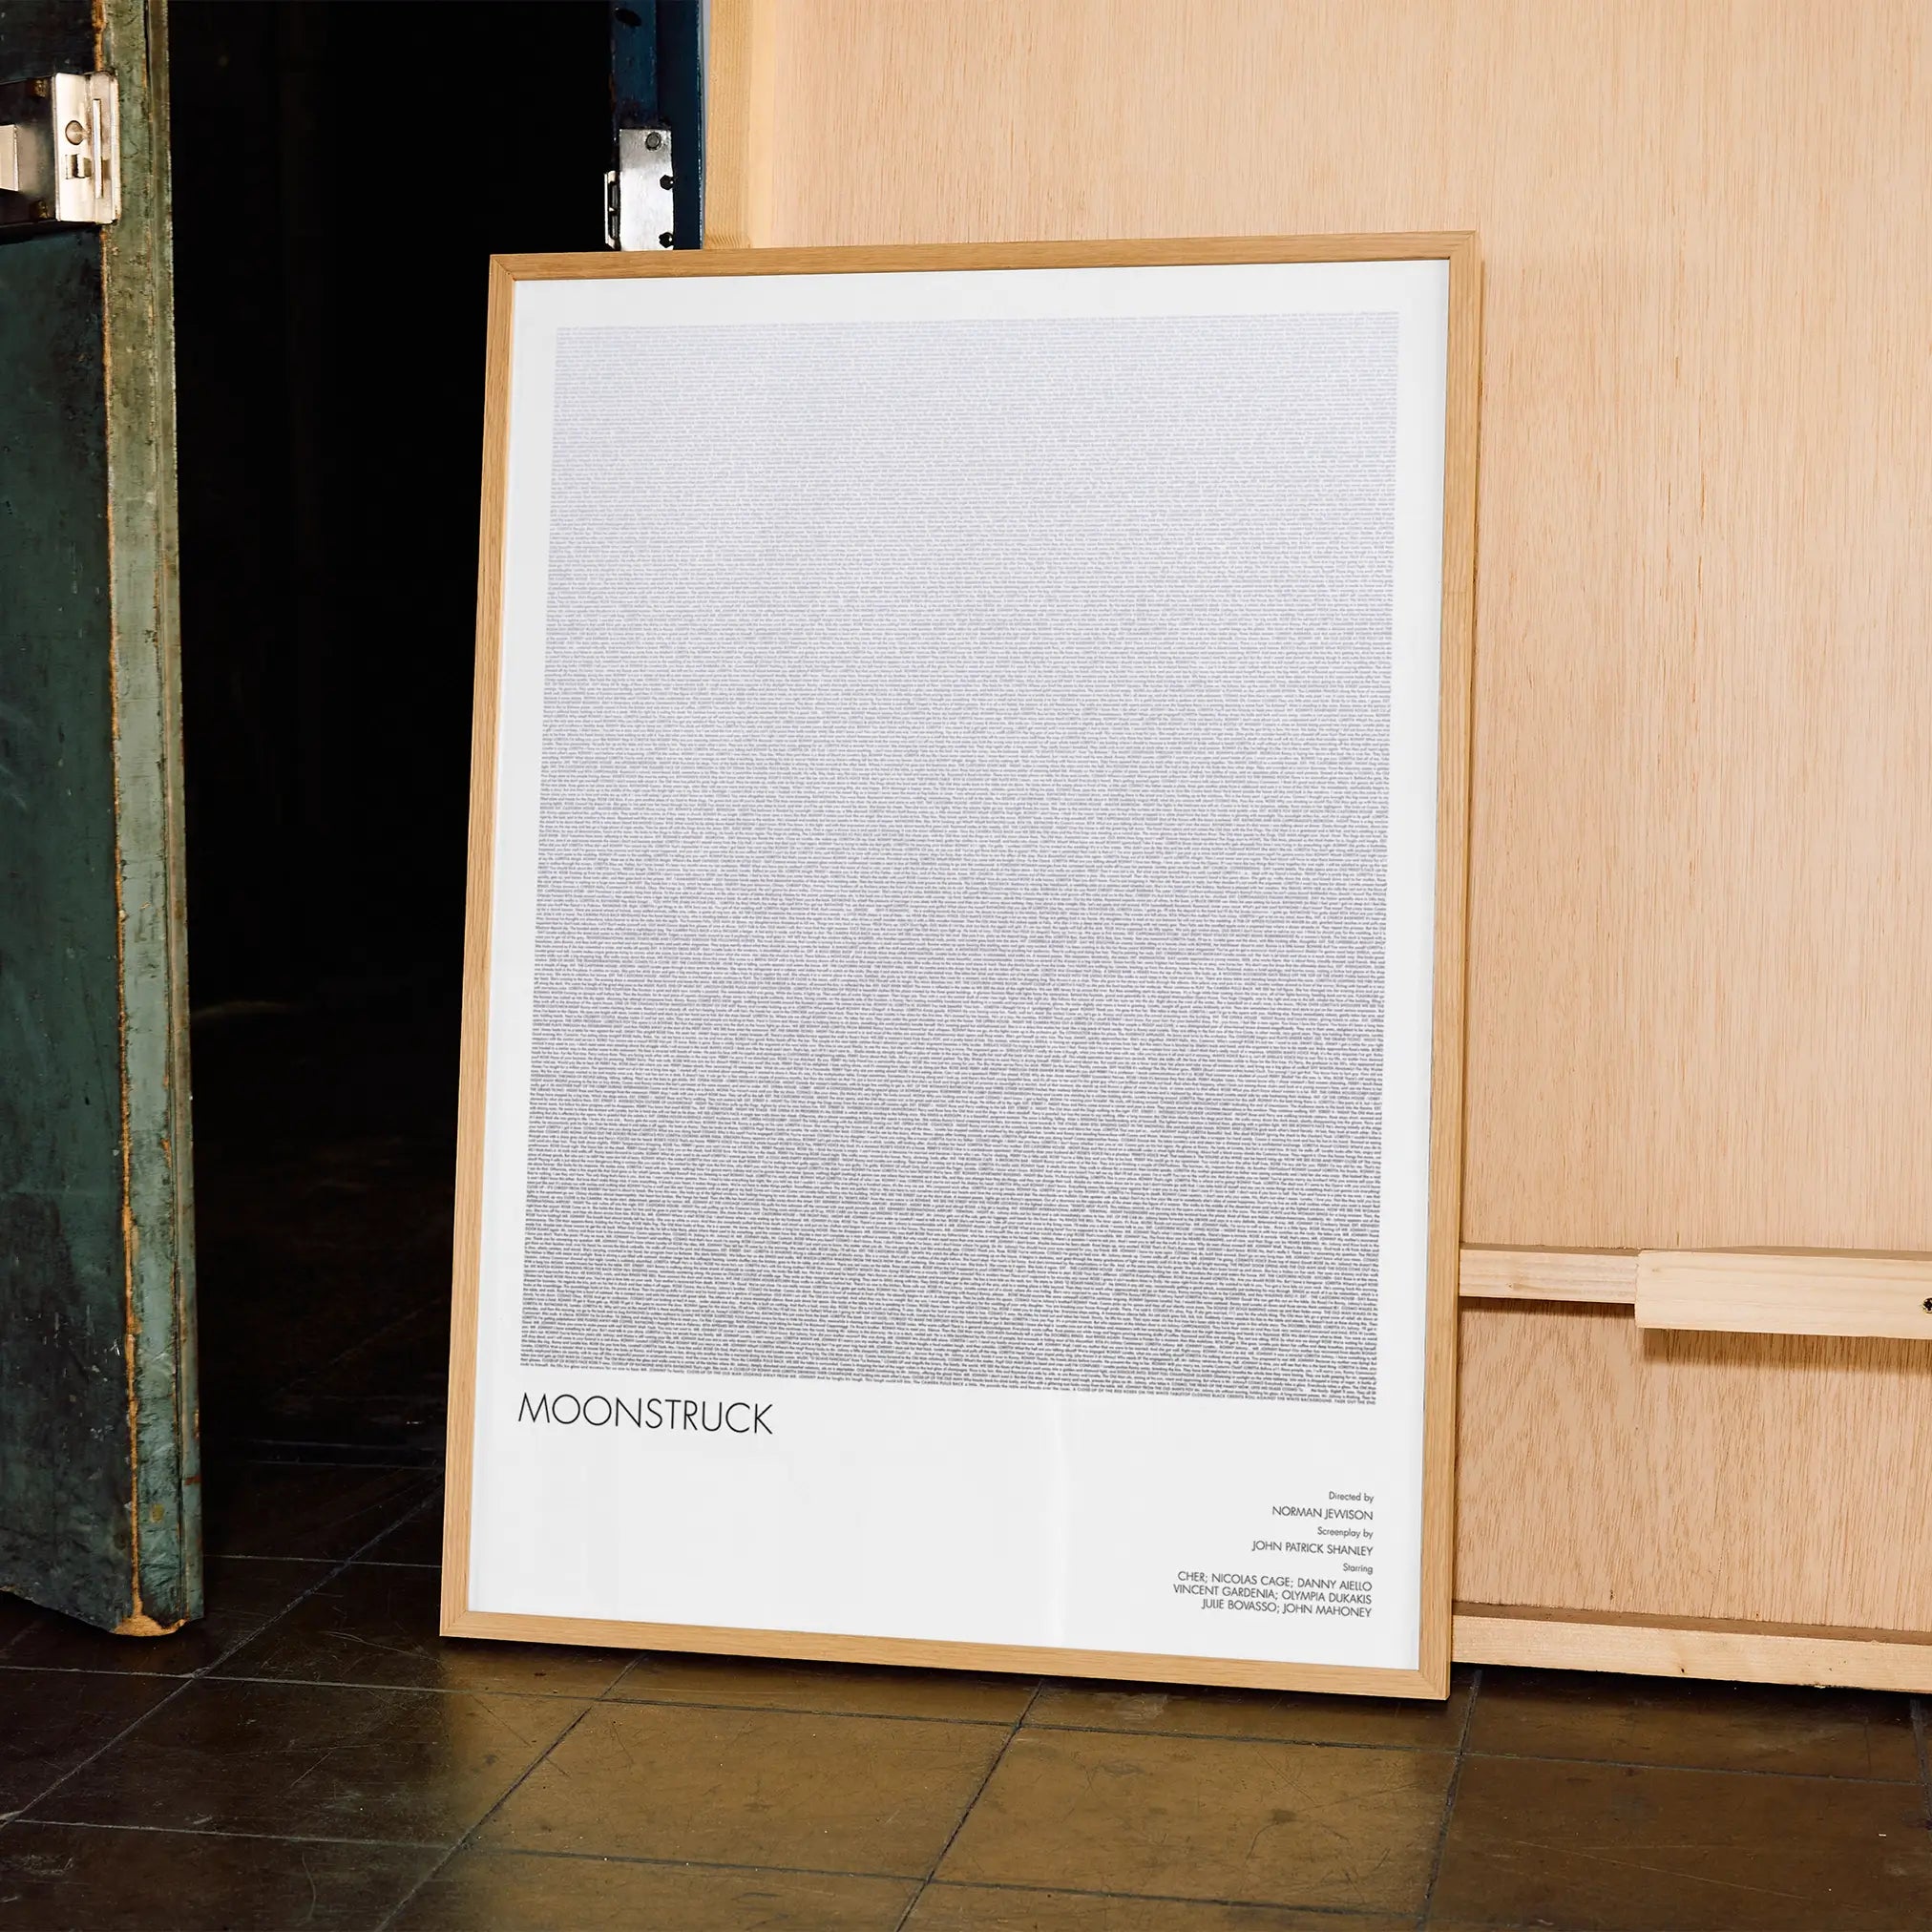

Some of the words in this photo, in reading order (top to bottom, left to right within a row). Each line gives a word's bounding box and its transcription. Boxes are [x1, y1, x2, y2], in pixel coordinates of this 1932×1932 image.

[517, 1391, 774, 1436] MOONSTRUCK
[1328, 1490, 1362, 1502] Directed
[1363, 1492, 1375, 1504] by
[1271, 1505, 1323, 1519] NORMAN
[1323, 1507, 1374, 1521] JEWISON
[1316, 1525, 1361, 1540] Screenplay
[1362, 1527, 1375, 1541] by
[1250, 1540, 1283, 1552] JOHN
[1285, 1542, 1325, 1555] PATRICK
[1326, 1544, 1374, 1557] SHANLEY
[1342, 1562, 1374, 1576] Starring
[1177, 1570, 1208, 1584] CHER;
[1211, 1572, 1258, 1586] NICOLAS
[1260, 1575, 1294, 1589] CAGE;
[1297, 1577, 1337, 1589] DANNY
[1338, 1580, 1373, 1592] AIELLO
[1172, 1583, 1220, 1596] VINCENT
[1222, 1586, 1279, 1601] GARDENIA;
[1281, 1589, 1326, 1603] OLYMPIA
[1328, 1591, 1373, 1606] DUKAKIS
[1200, 1598, 1225, 1610] JULIE
[1227, 1599, 1280, 1615] BOVASSO;
[1281, 1603, 1313, 1615] JOHN
[1314, 1605, 1373, 1618] MAHONEY
